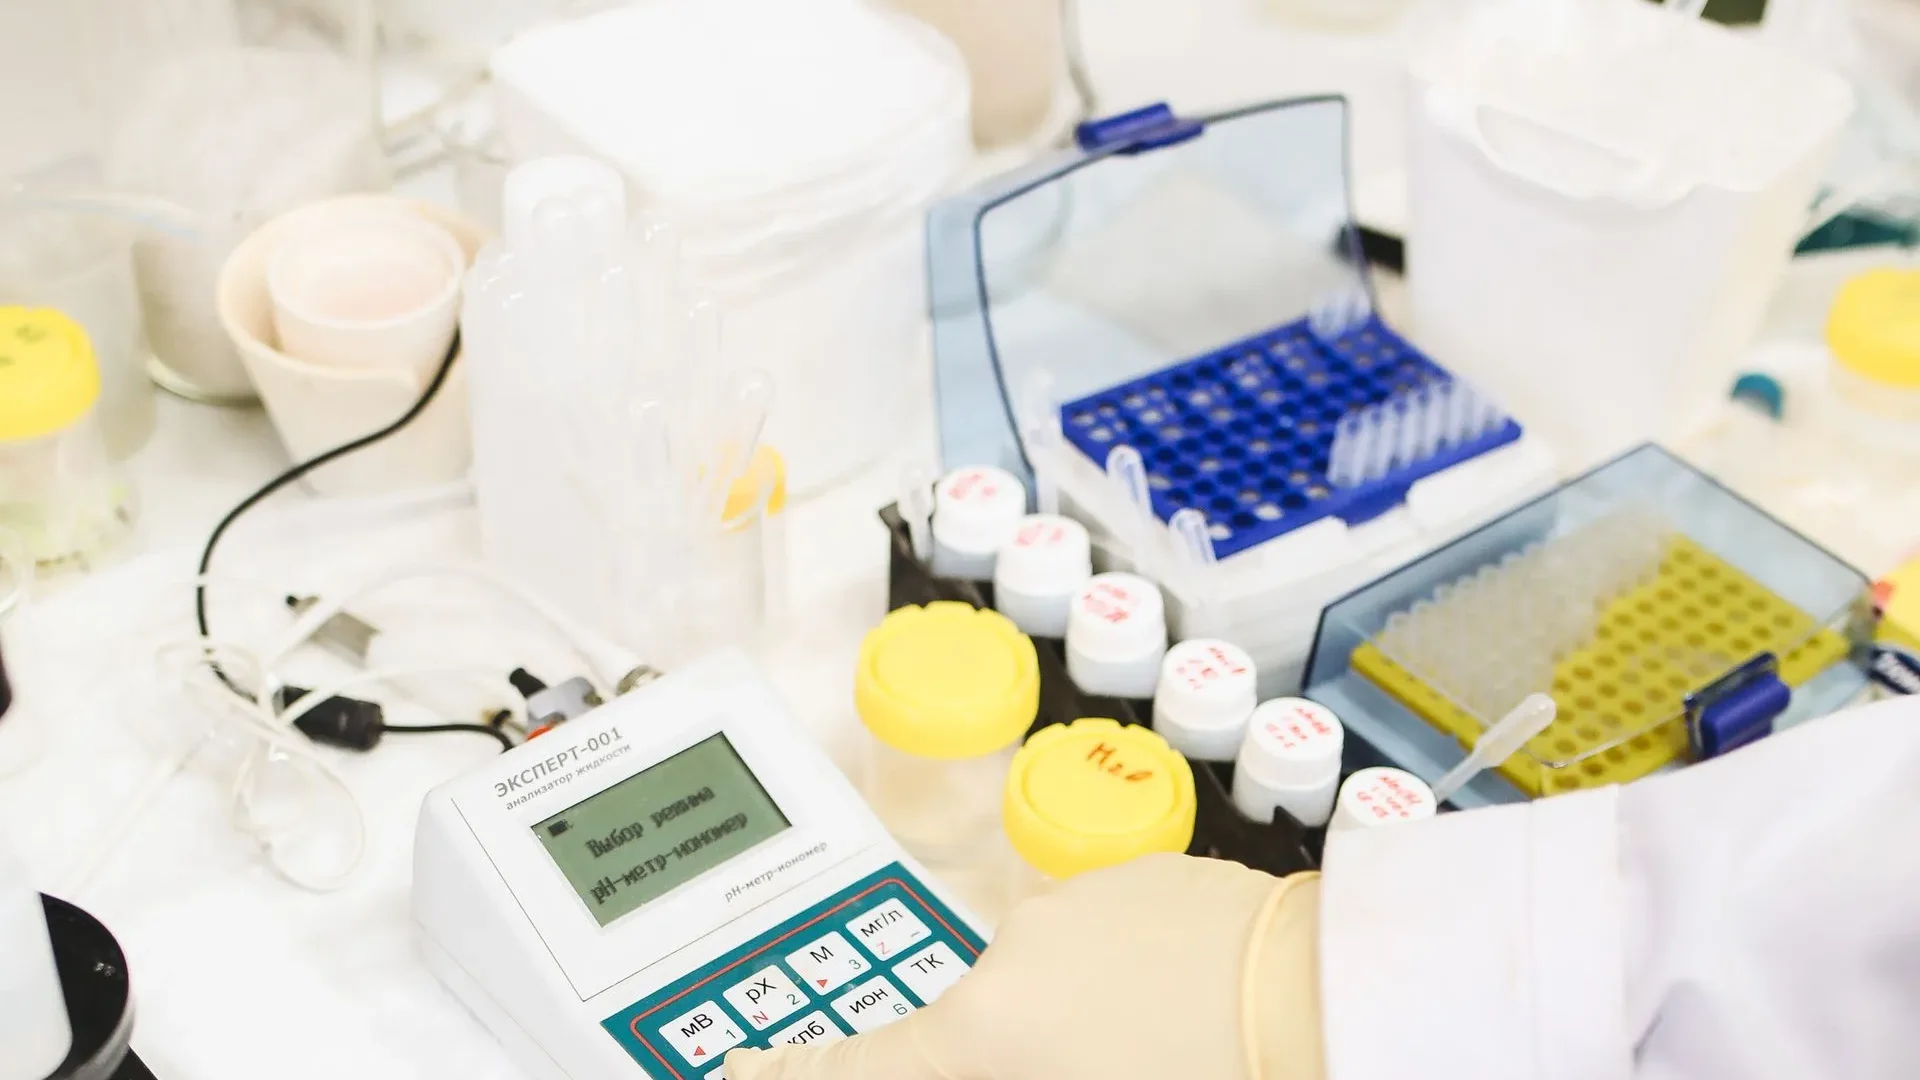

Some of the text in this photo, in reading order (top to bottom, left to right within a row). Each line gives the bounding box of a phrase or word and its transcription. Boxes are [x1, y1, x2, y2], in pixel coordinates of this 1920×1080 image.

[494, 727, 623, 797] ЭКСПЕРТ-001
[506, 744, 631, 810] анализатор жидкости
[585, 822, 644, 858] Выбор
[860, 910, 903, 937] мг/л
[848, 959, 861, 970] 3
[910, 953, 944, 974] ТК
[786, 993, 800, 1005] 2
[849, 988, 888, 1014] ион
[893, 1003, 908, 1015] 6
[680, 1014, 714, 1037] мВ
[726, 1029, 736, 1039] 1
